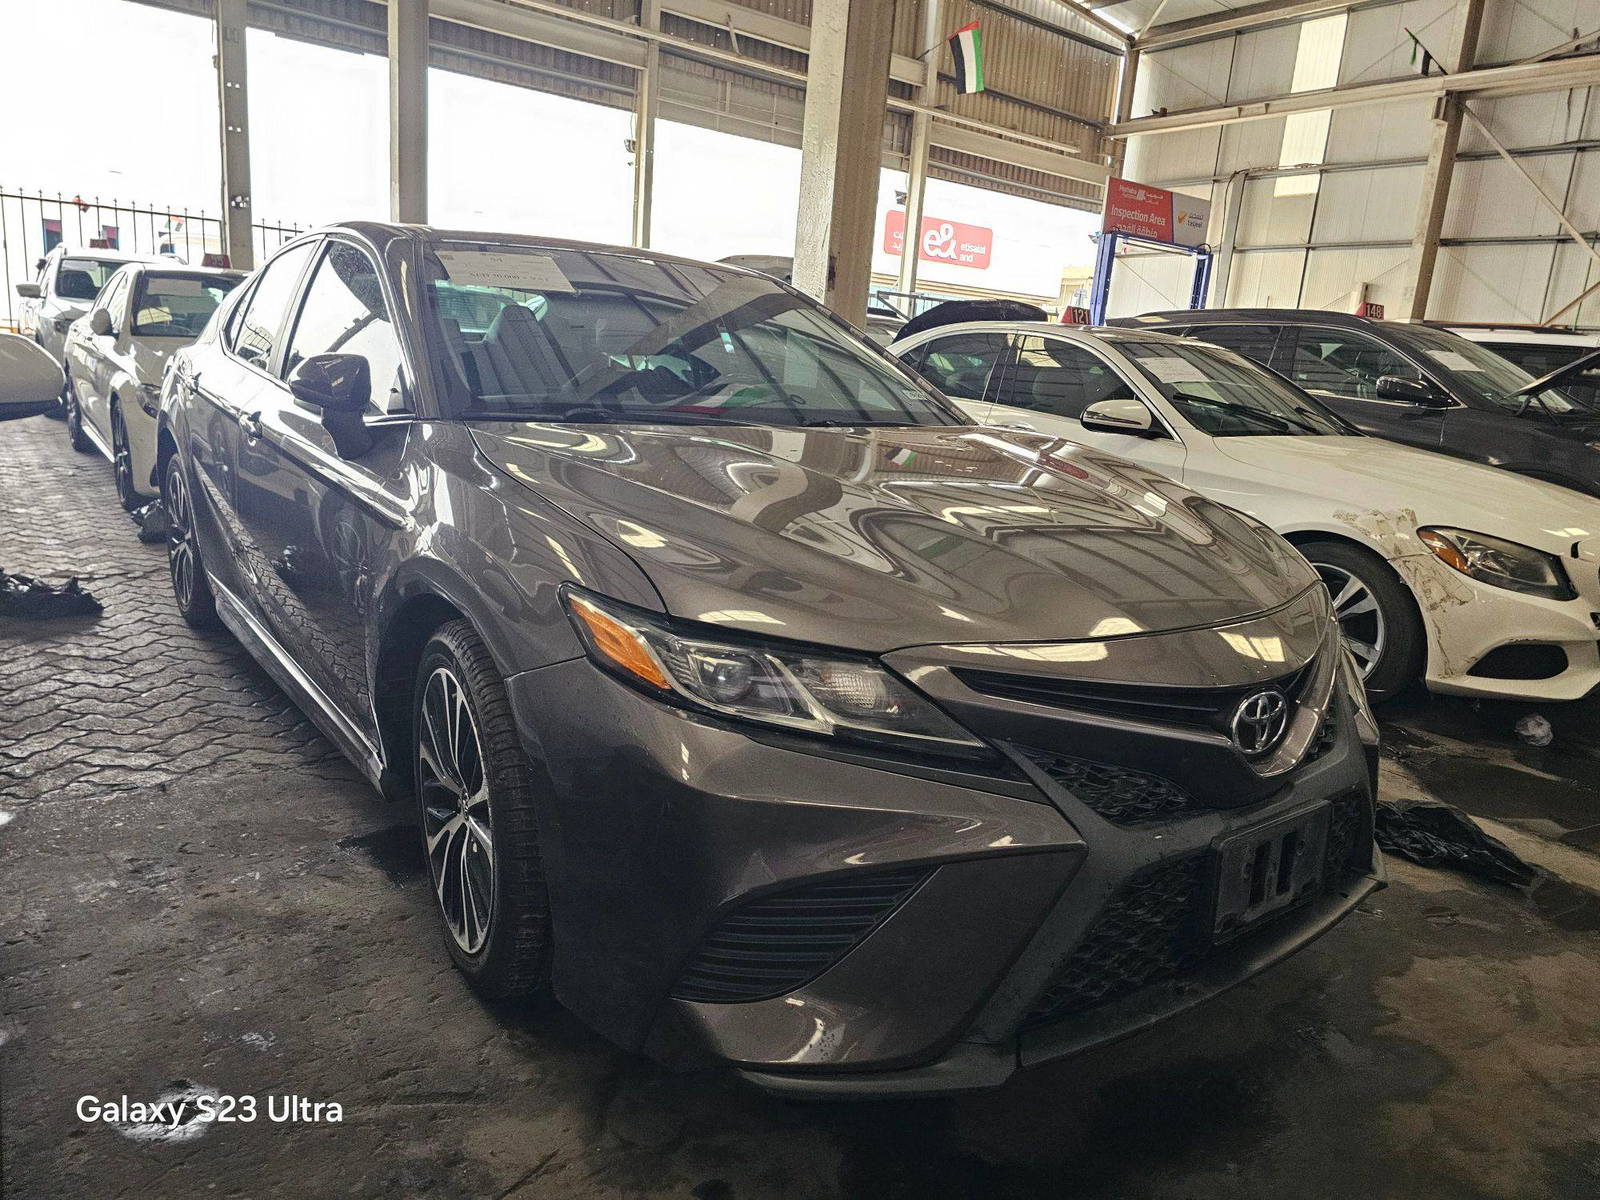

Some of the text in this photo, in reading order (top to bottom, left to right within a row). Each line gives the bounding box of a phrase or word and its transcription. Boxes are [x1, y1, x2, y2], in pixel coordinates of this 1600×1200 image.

[1111, 204, 1166, 226] Inspection Area
[960, 243, 986, 255] etisalat
[959, 253, 974, 263] and
[1073, 308, 1089, 325] 121
[1366, 304, 1381, 319] 148
